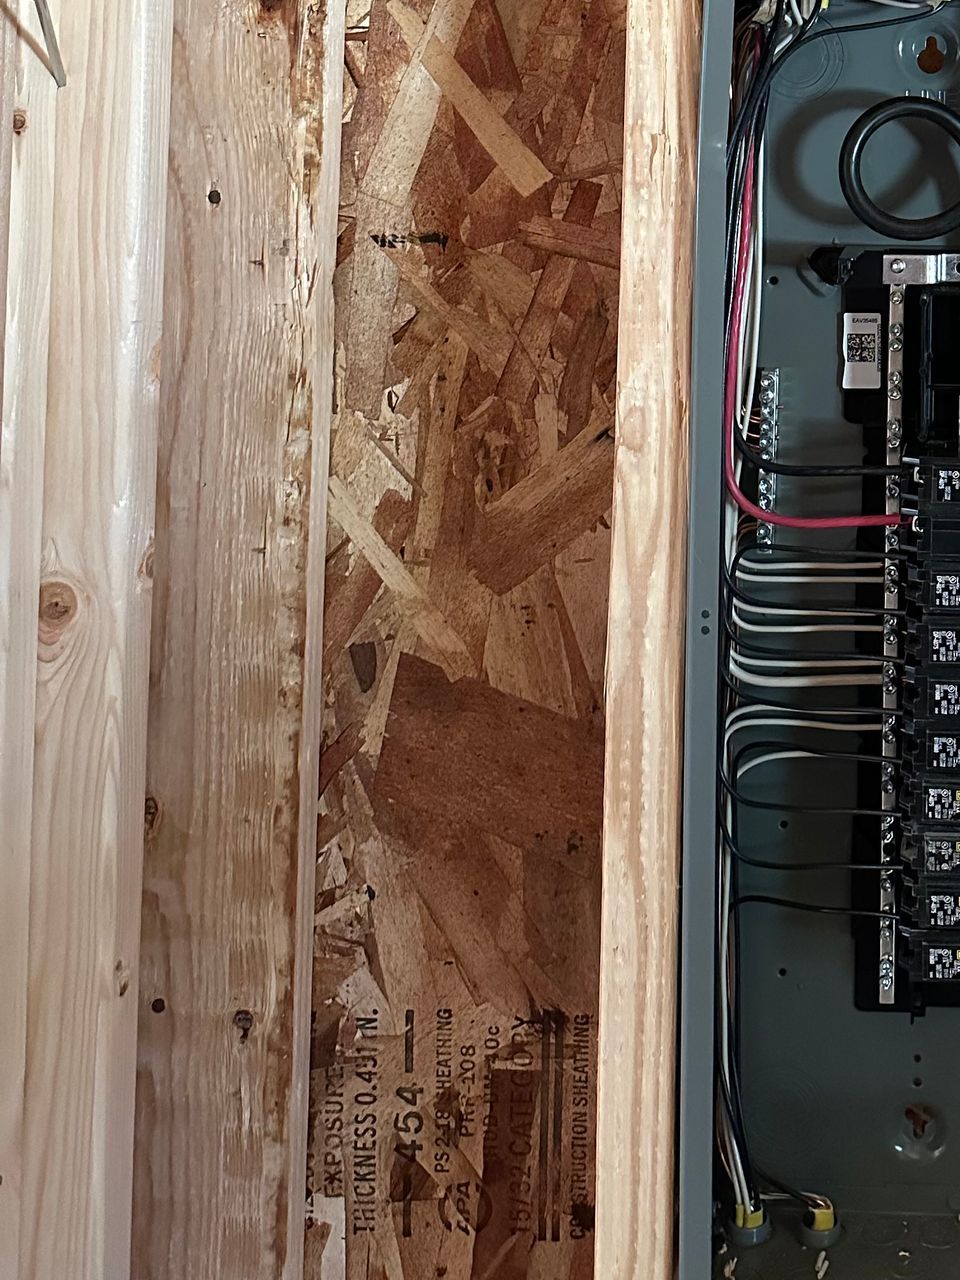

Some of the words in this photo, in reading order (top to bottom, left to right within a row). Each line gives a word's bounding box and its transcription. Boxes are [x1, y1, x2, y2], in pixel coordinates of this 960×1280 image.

[509, 1015, 537, 1156] CATEGORY
[571, 1013, 591, 1107] SHEATHING
[323, 1061, 346, 1199] EXPOSURE
[352, 1113, 376, 1236] THICKNESS
[393, 1082, 425, 1163] 454
[434, 1152, 450, 1173] PS
[569, 1111, 590, 1240] COSTRUCTION
